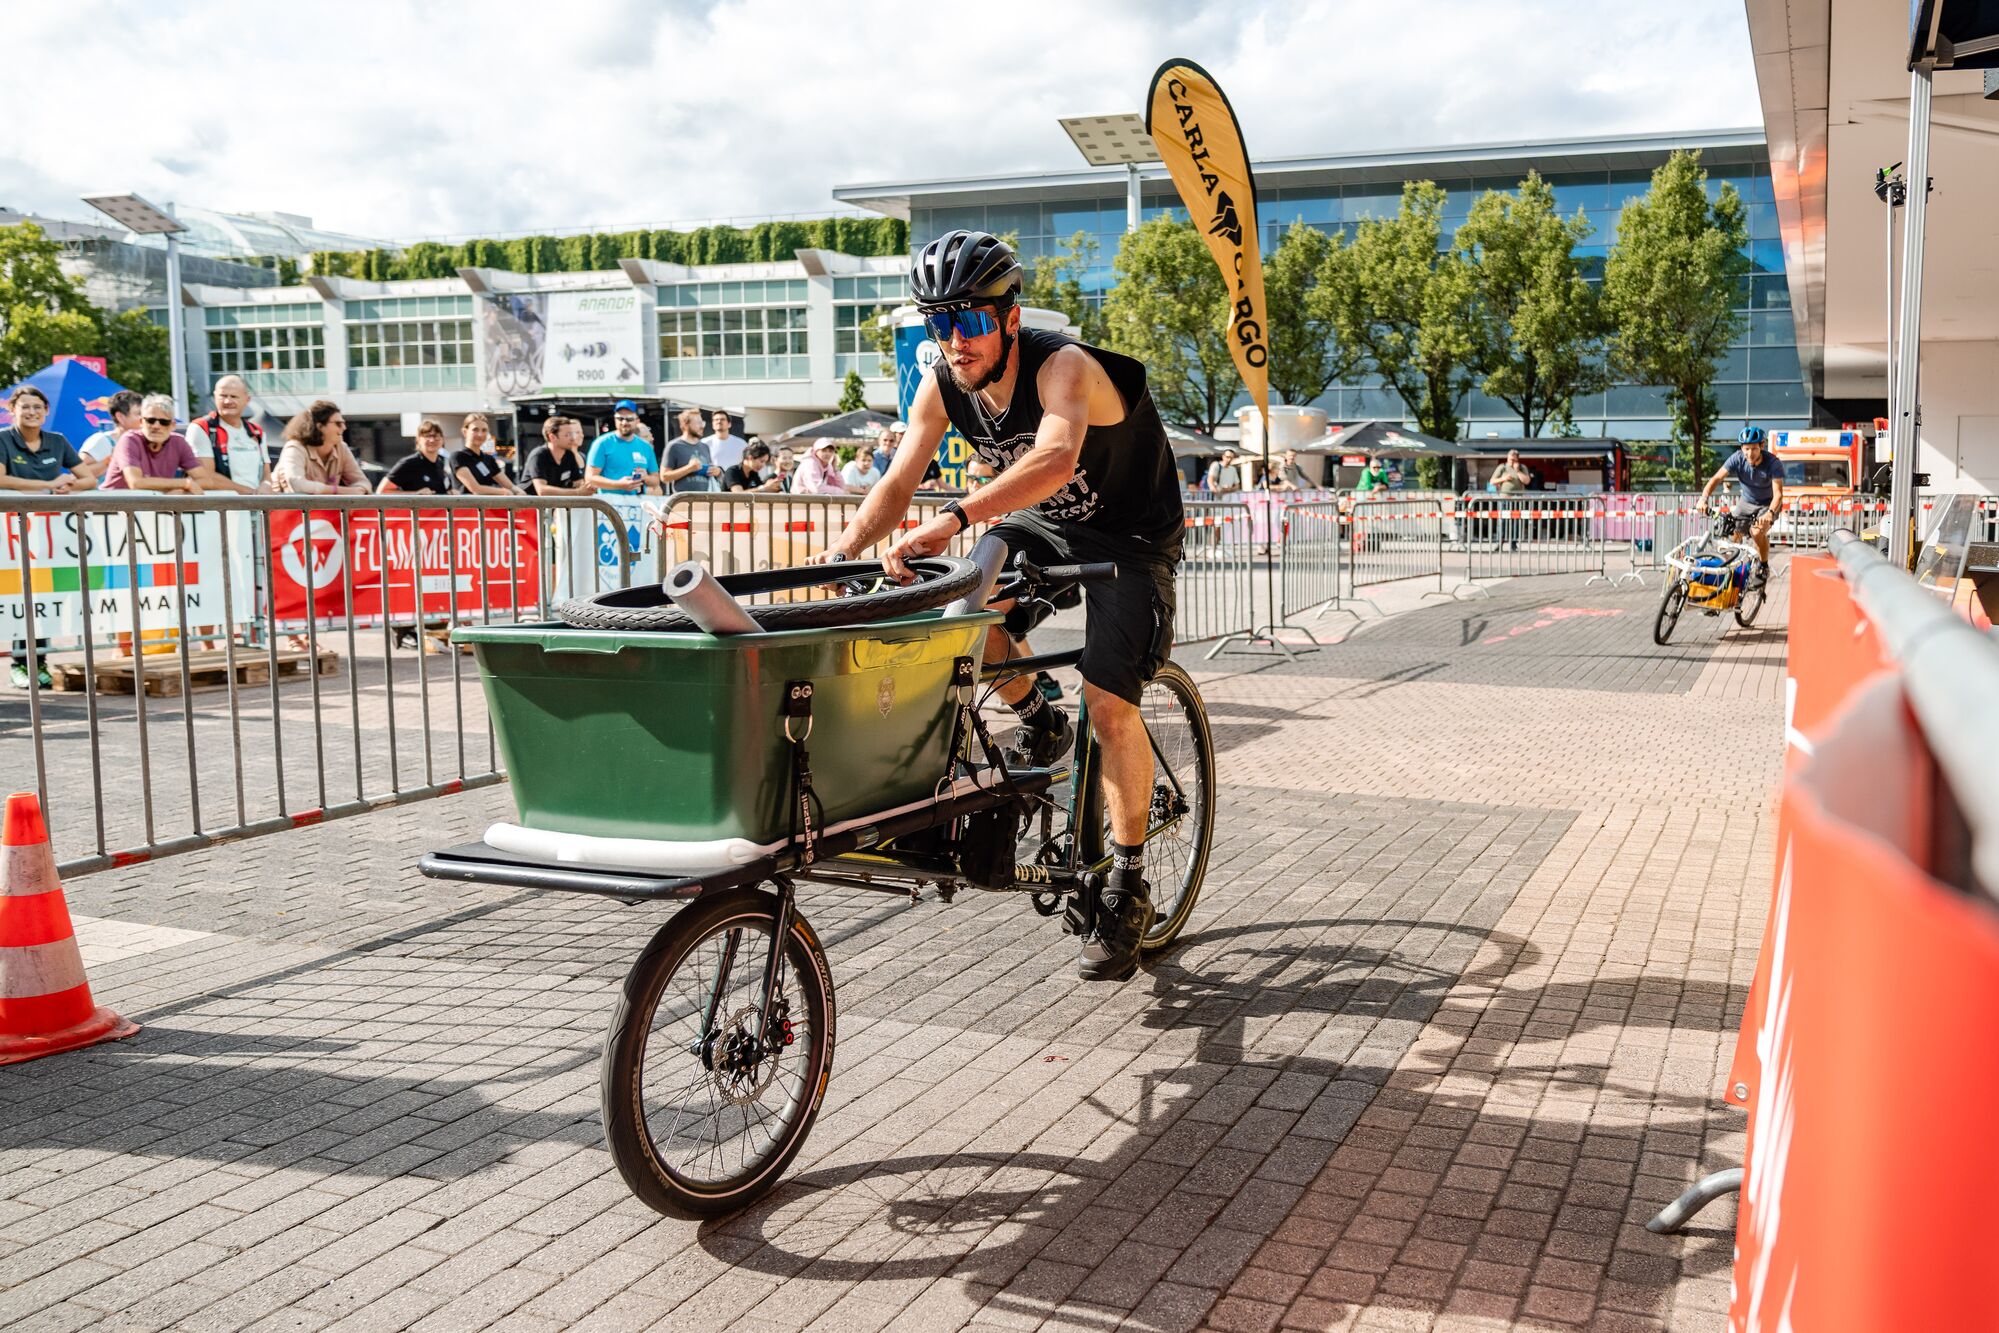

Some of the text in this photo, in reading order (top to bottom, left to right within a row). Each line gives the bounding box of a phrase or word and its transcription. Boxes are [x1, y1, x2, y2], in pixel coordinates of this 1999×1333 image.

[1168, 78, 1220, 197] CARLA
[577, 296, 636, 312] ANANDA
[577, 368, 605, 381] R900
[354, 526, 527, 572] FLAMME ROUGE
[801, 793, 813, 849] bergzeit
[814, 951, 832, 1000] CONTACT
